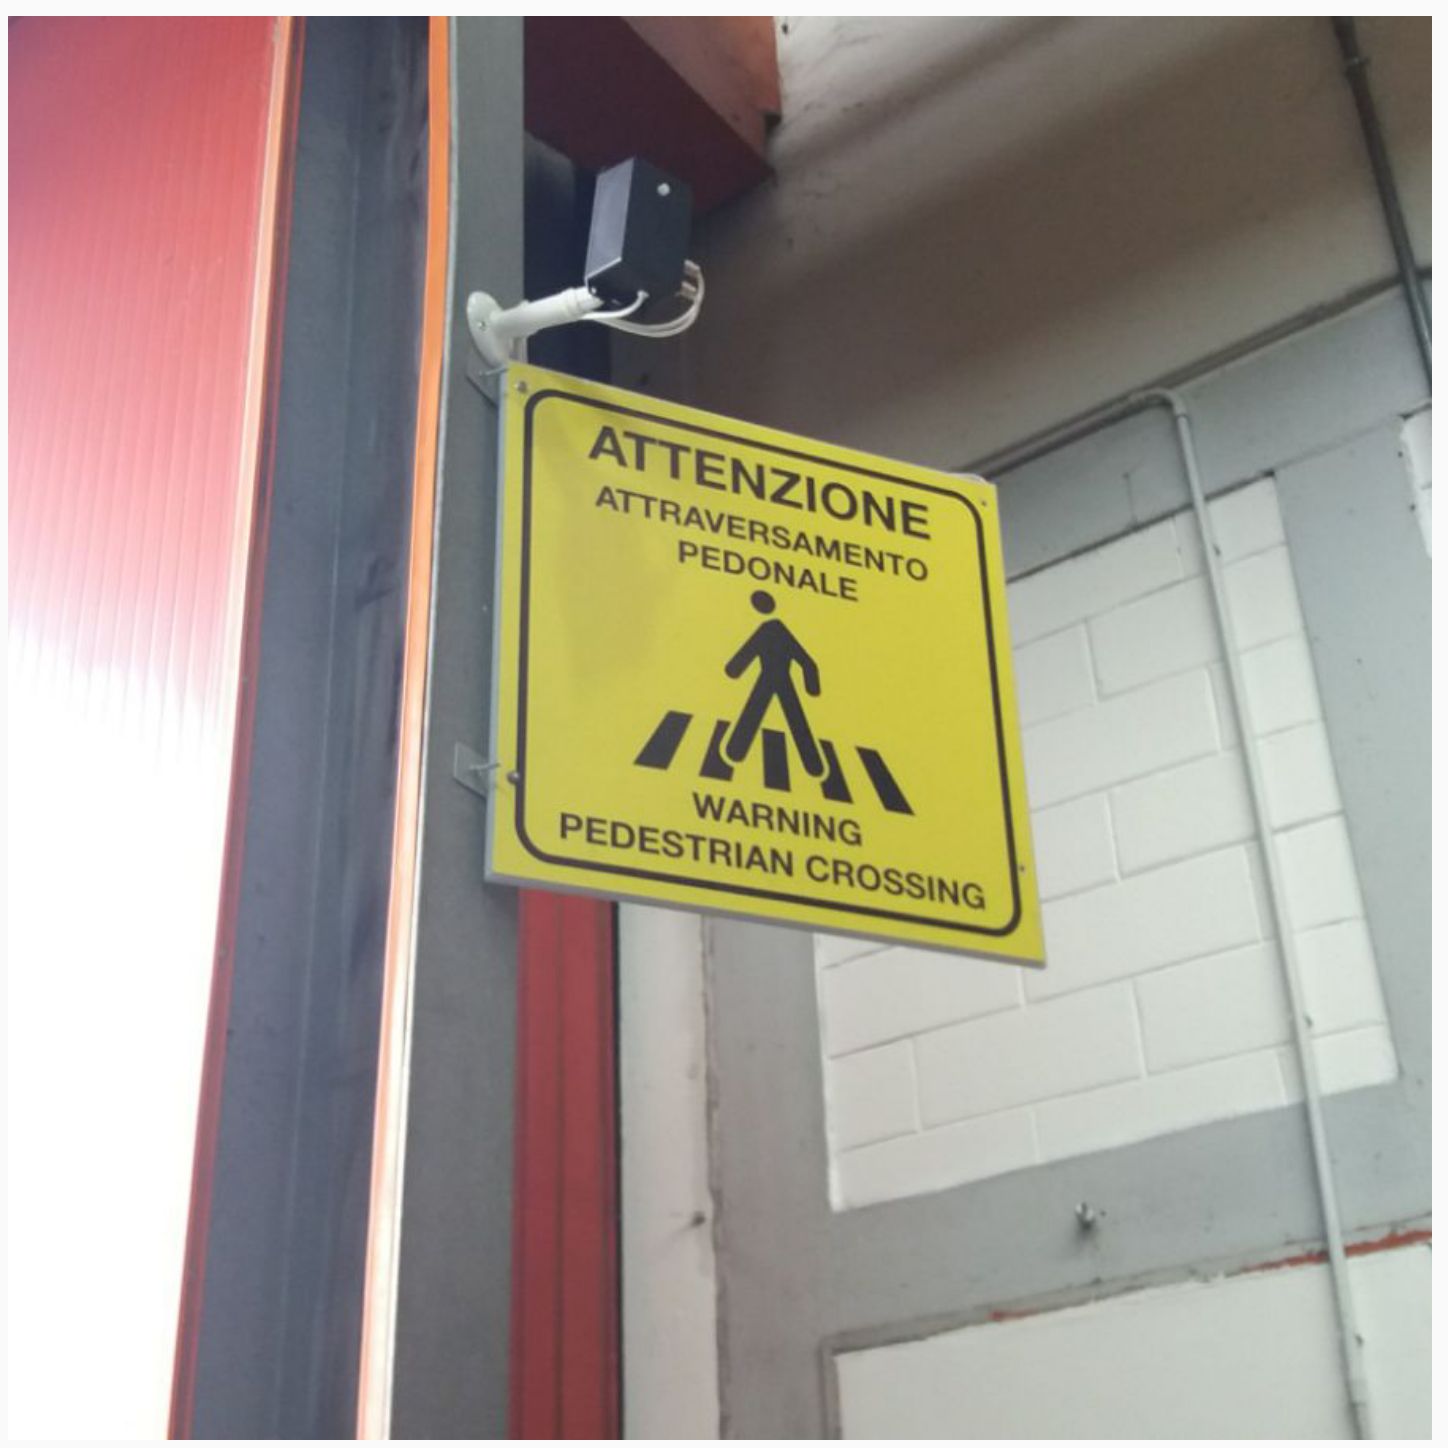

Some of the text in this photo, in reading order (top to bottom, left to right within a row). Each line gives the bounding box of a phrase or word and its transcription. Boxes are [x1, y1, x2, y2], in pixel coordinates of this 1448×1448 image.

[588, 425, 932, 541] ATTENZIONE
[595, 485, 929, 582] ATTRAVERSAMENTO
[678, 541, 859, 602] PEDONALE
[559, 812, 986, 911] PEDESTRIAN CROSSING
[692, 791, 863, 847] WARNING
